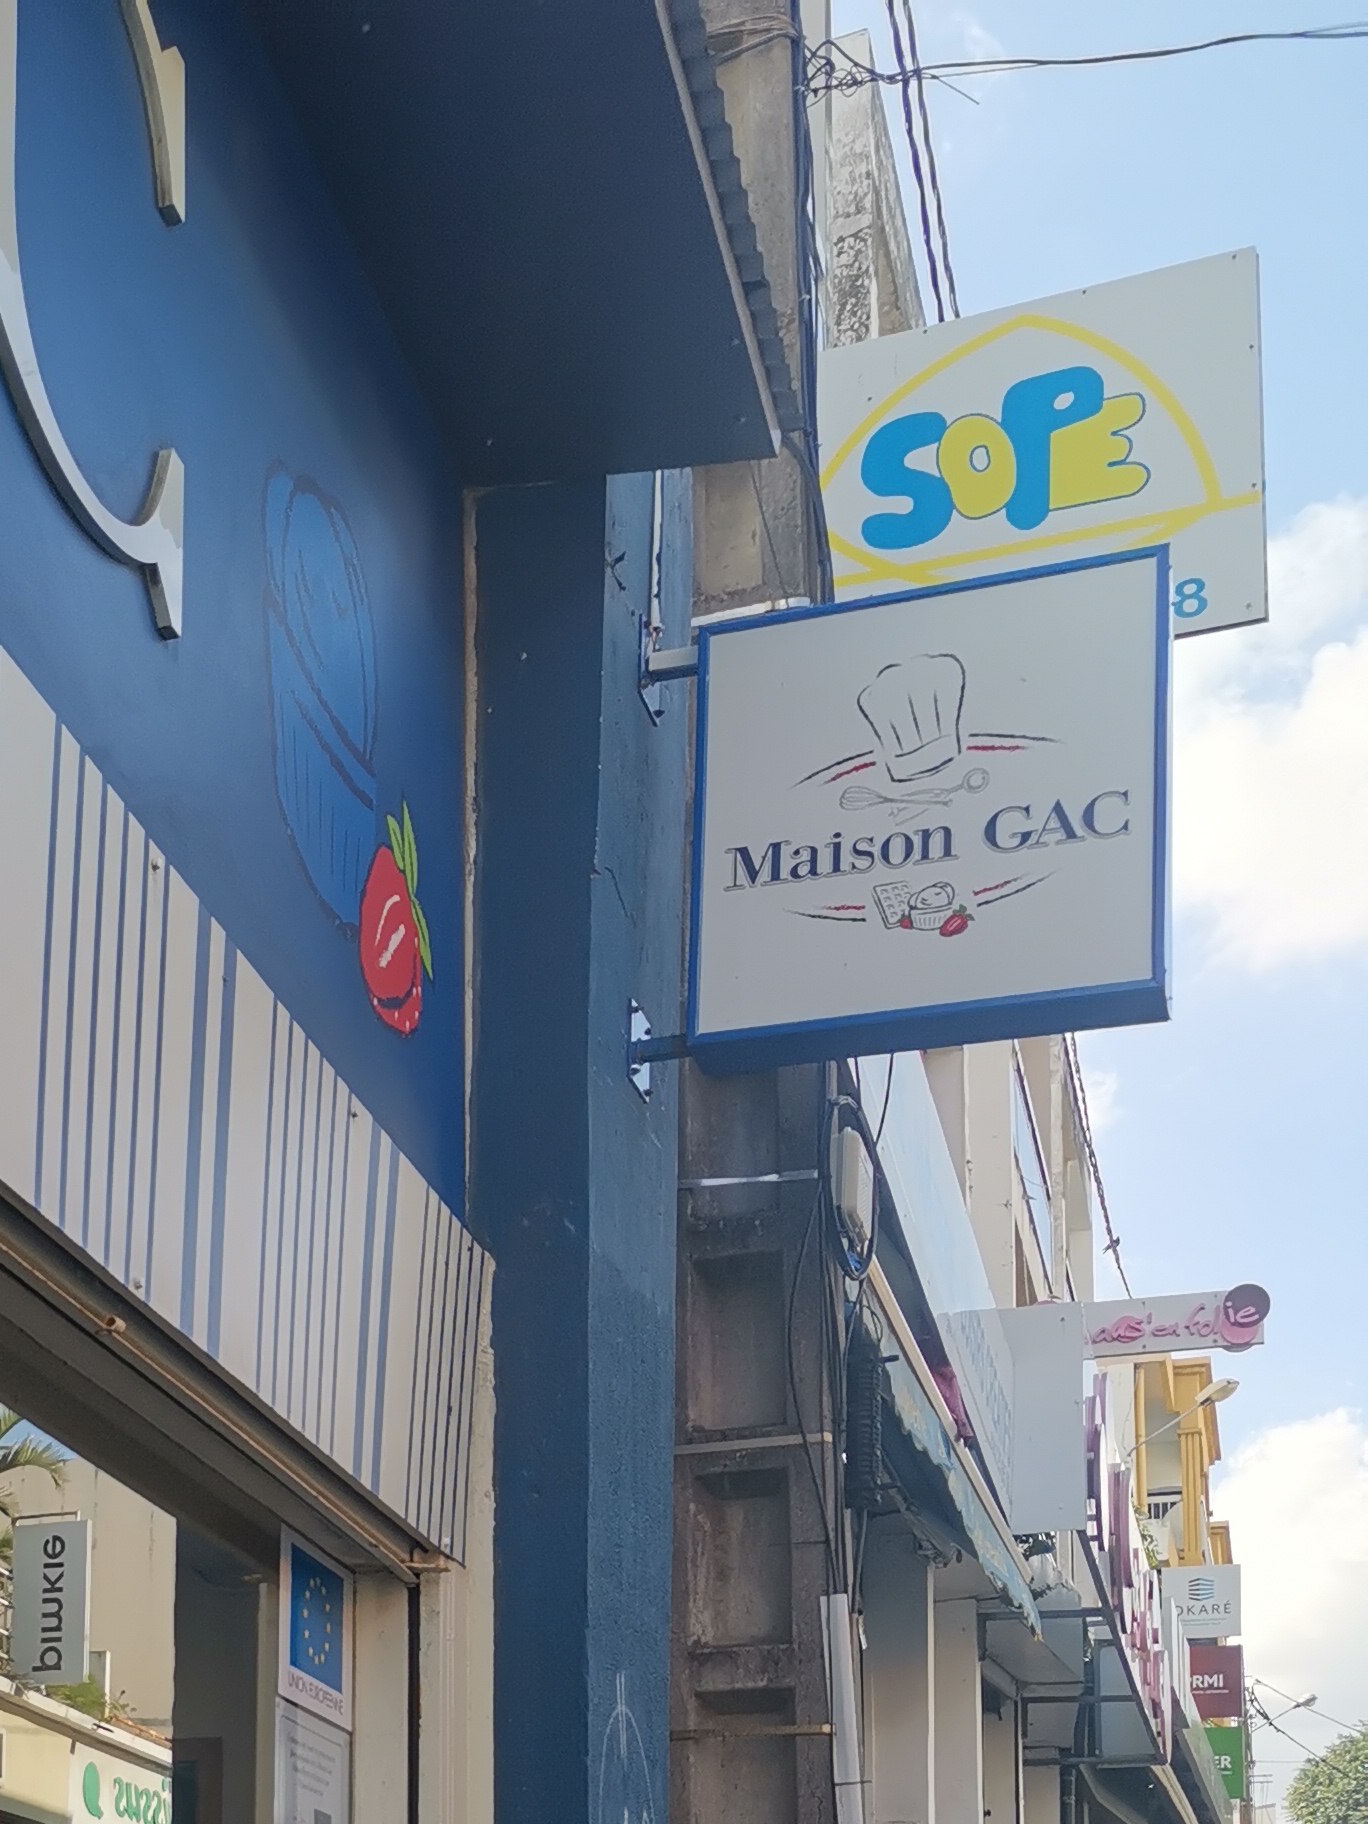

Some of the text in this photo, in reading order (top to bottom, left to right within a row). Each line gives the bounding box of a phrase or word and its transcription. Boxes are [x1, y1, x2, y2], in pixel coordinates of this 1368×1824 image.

[861, 366, 1151, 550] SOPE
[723, 790, 1132, 892] Maison GAC
[1190, 1674, 1223, 1688] RMI
